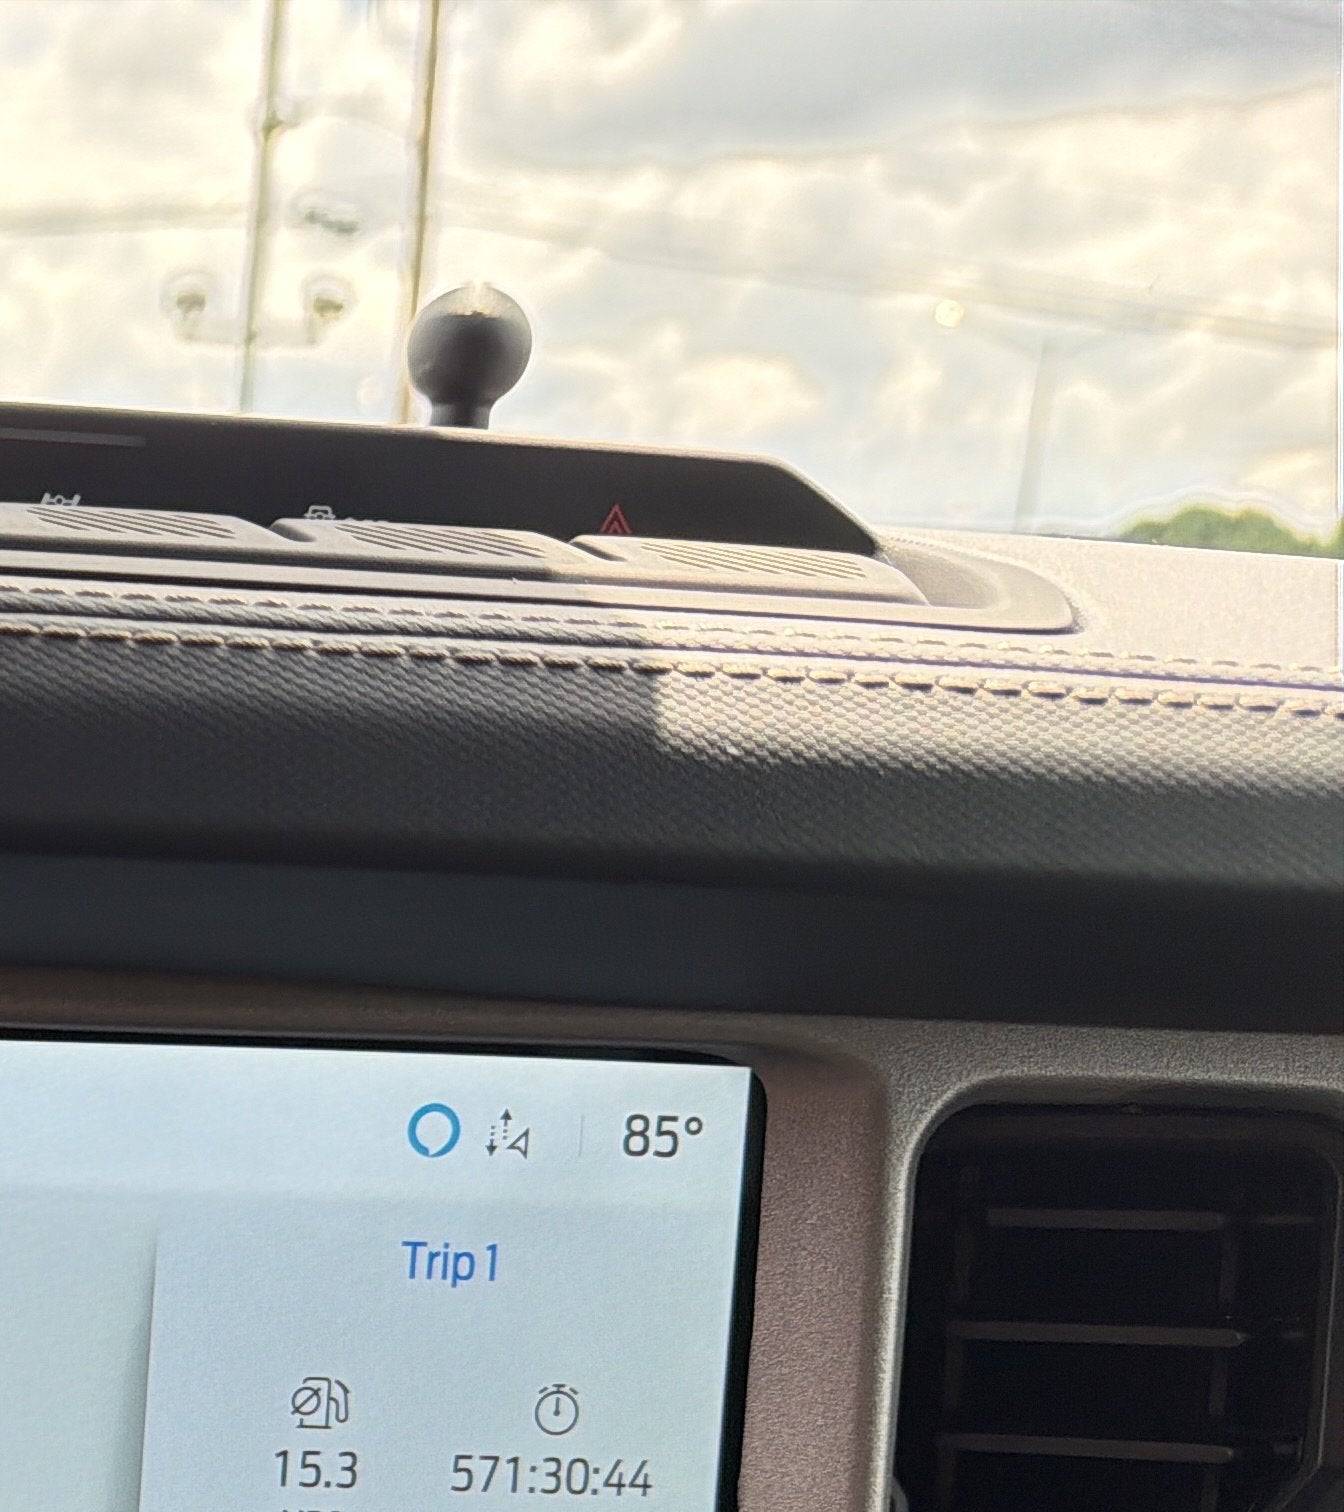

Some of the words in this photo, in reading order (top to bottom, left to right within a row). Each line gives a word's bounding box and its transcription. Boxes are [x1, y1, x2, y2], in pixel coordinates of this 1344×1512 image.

[622, 1114, 703, 1159] 85°
[401, 1240, 475, 1288] Trip
[485, 1243, 499, 1282] 1
[274, 1449, 359, 1490] 15.3
[450, 1455, 653, 1498] 571:30:44
